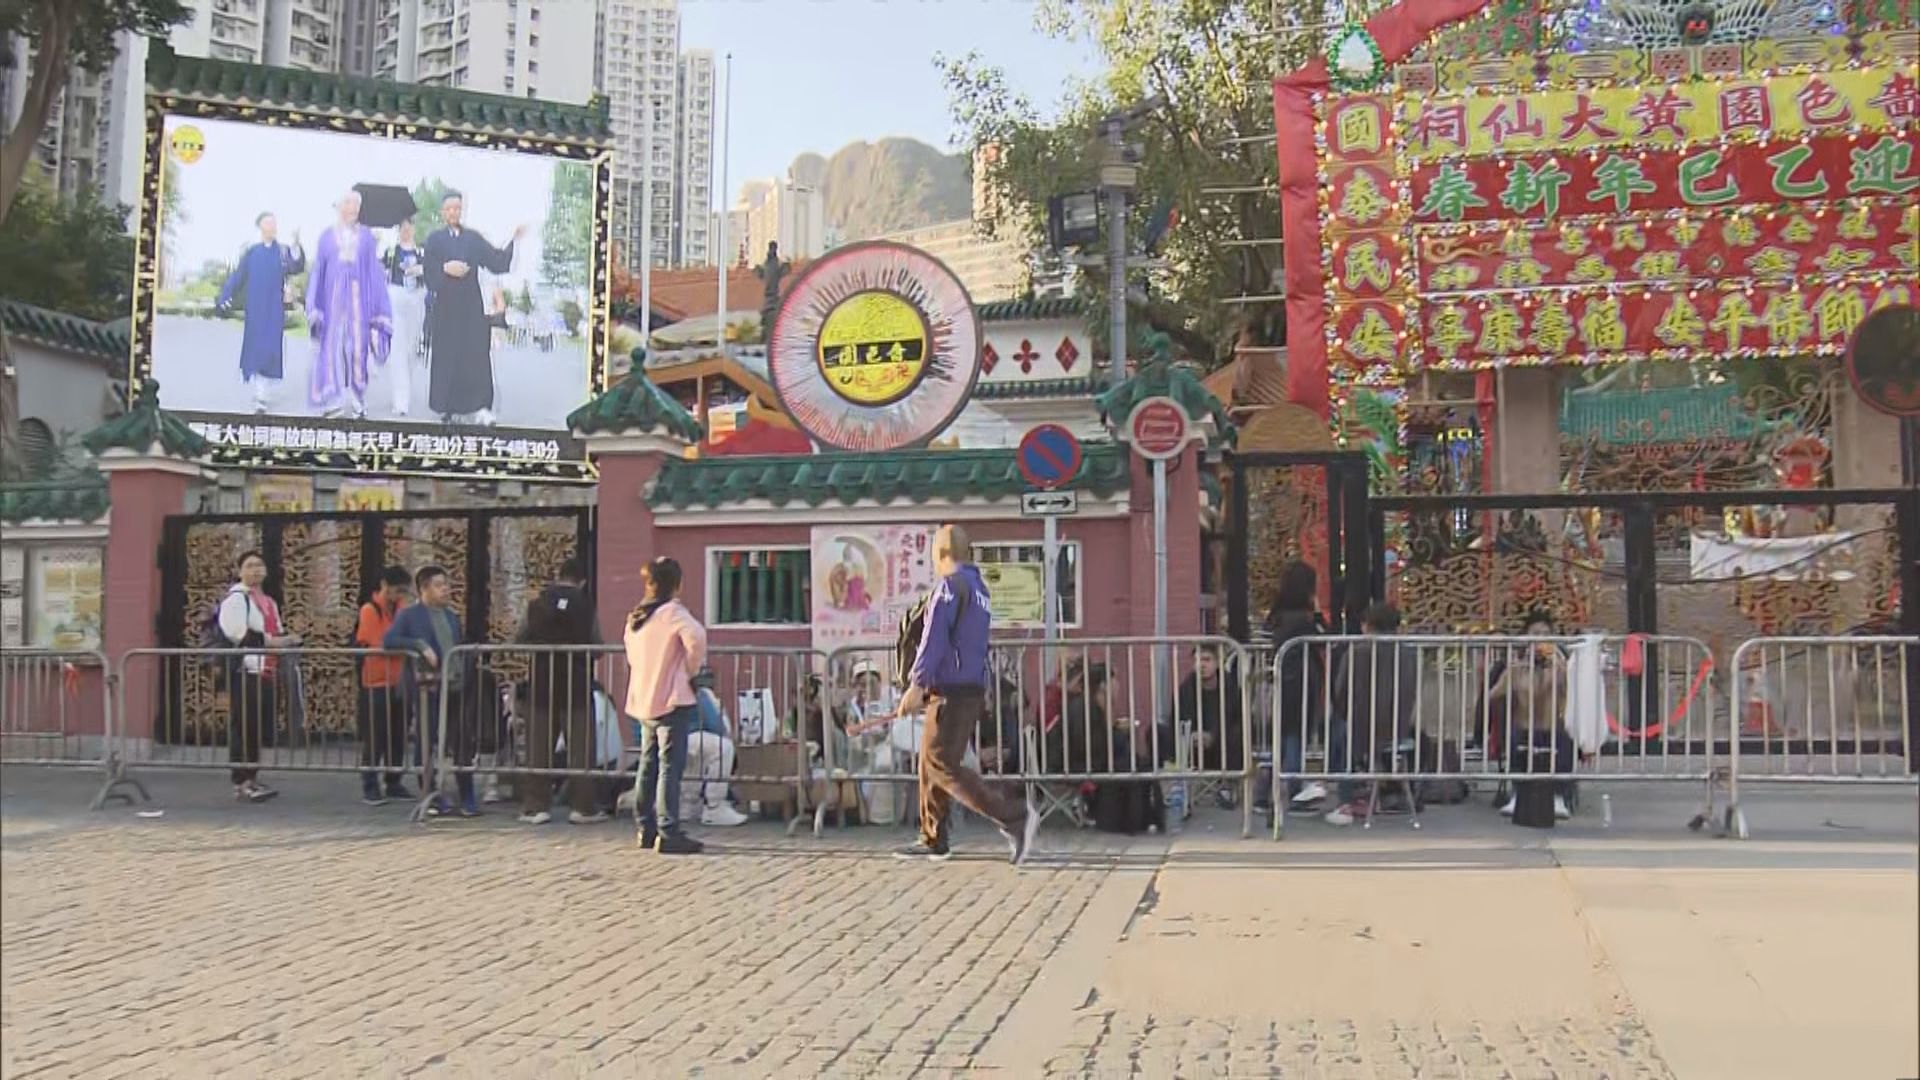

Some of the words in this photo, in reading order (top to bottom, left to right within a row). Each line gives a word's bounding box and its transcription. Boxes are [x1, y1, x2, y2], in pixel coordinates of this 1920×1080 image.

[1416, 136, 1919, 221] 迎乙巳年新春
[1337, 102, 1398, 360] 國泰民安
[1657, 284, 1911, 352] 師保平安
